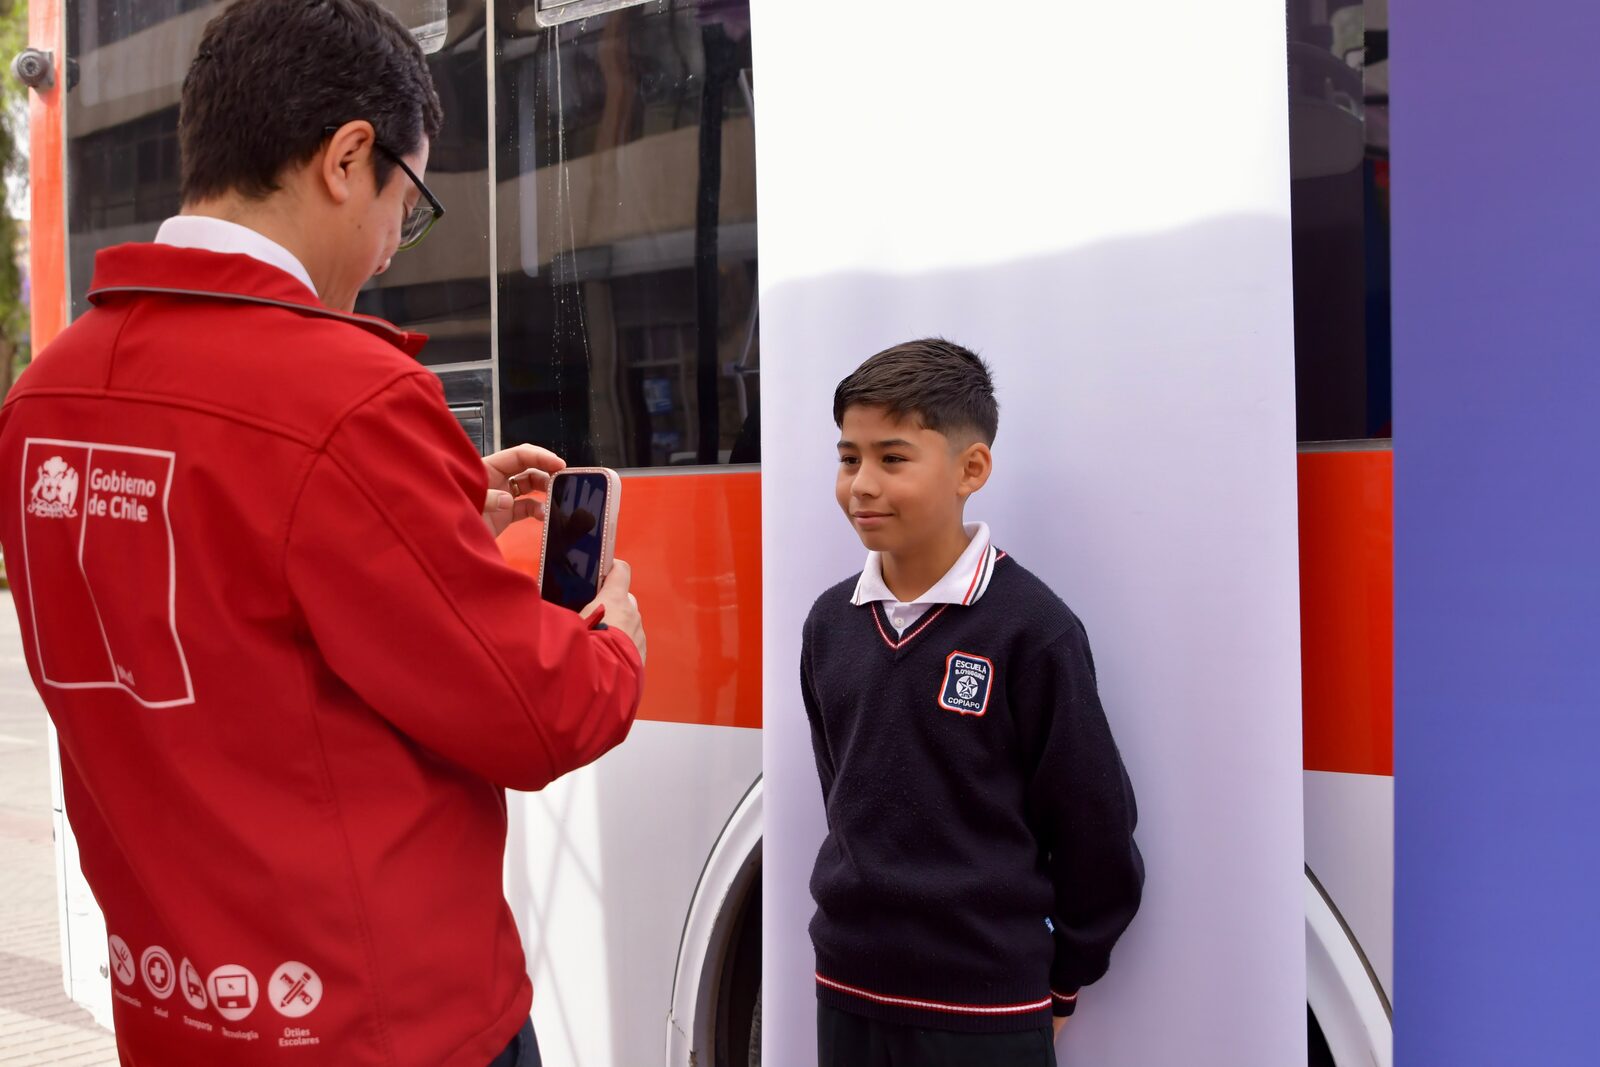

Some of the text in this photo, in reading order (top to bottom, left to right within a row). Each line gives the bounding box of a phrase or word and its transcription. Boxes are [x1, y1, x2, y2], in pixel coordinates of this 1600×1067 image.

[90, 467, 156, 498] Gobierno
[87, 492, 149, 523] de Chile
[955, 659, 987, 675] ESCUELA
[278, 1037, 320, 1047] Escolares
